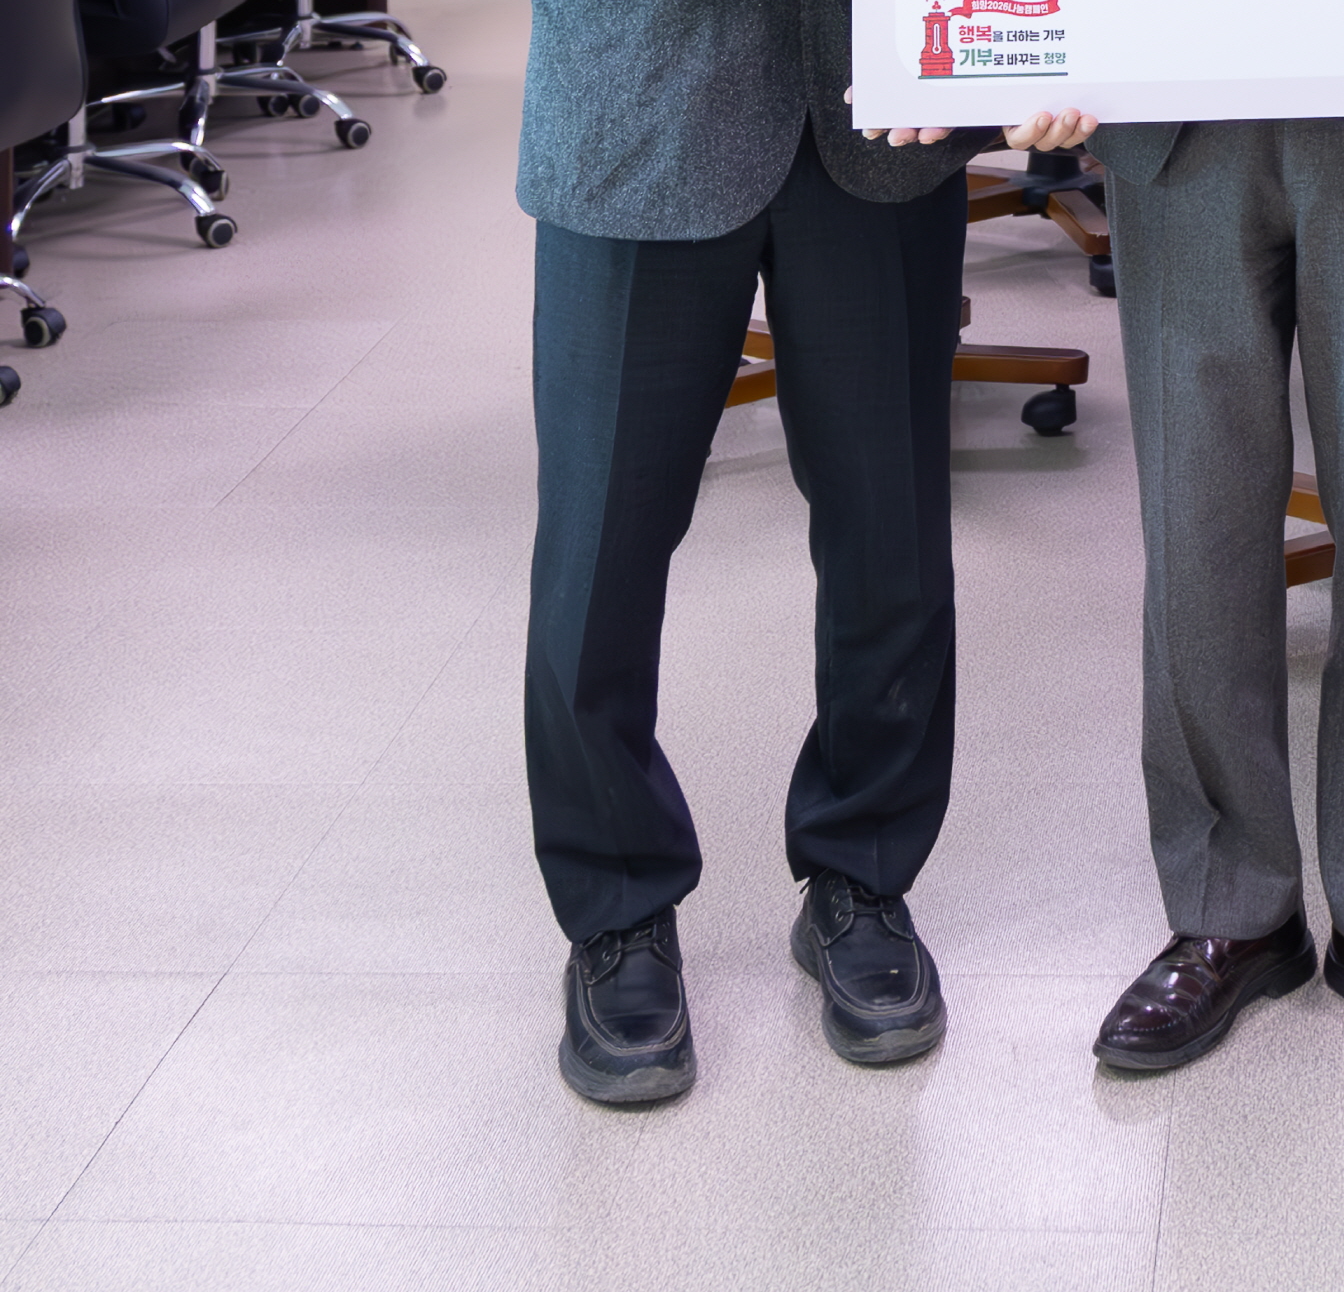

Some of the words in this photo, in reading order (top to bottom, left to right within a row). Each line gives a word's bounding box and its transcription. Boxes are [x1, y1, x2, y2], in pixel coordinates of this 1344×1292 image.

[958, 24, 1004, 44] 행복을
[1006, 29, 1040, 43] 더하는
[1043, 29, 1066, 42] 기부
[958, 48, 1004, 67] 기부로
[1006, 52, 1040, 66] 바꾸는
[1043, 52, 1067, 65] 청양
